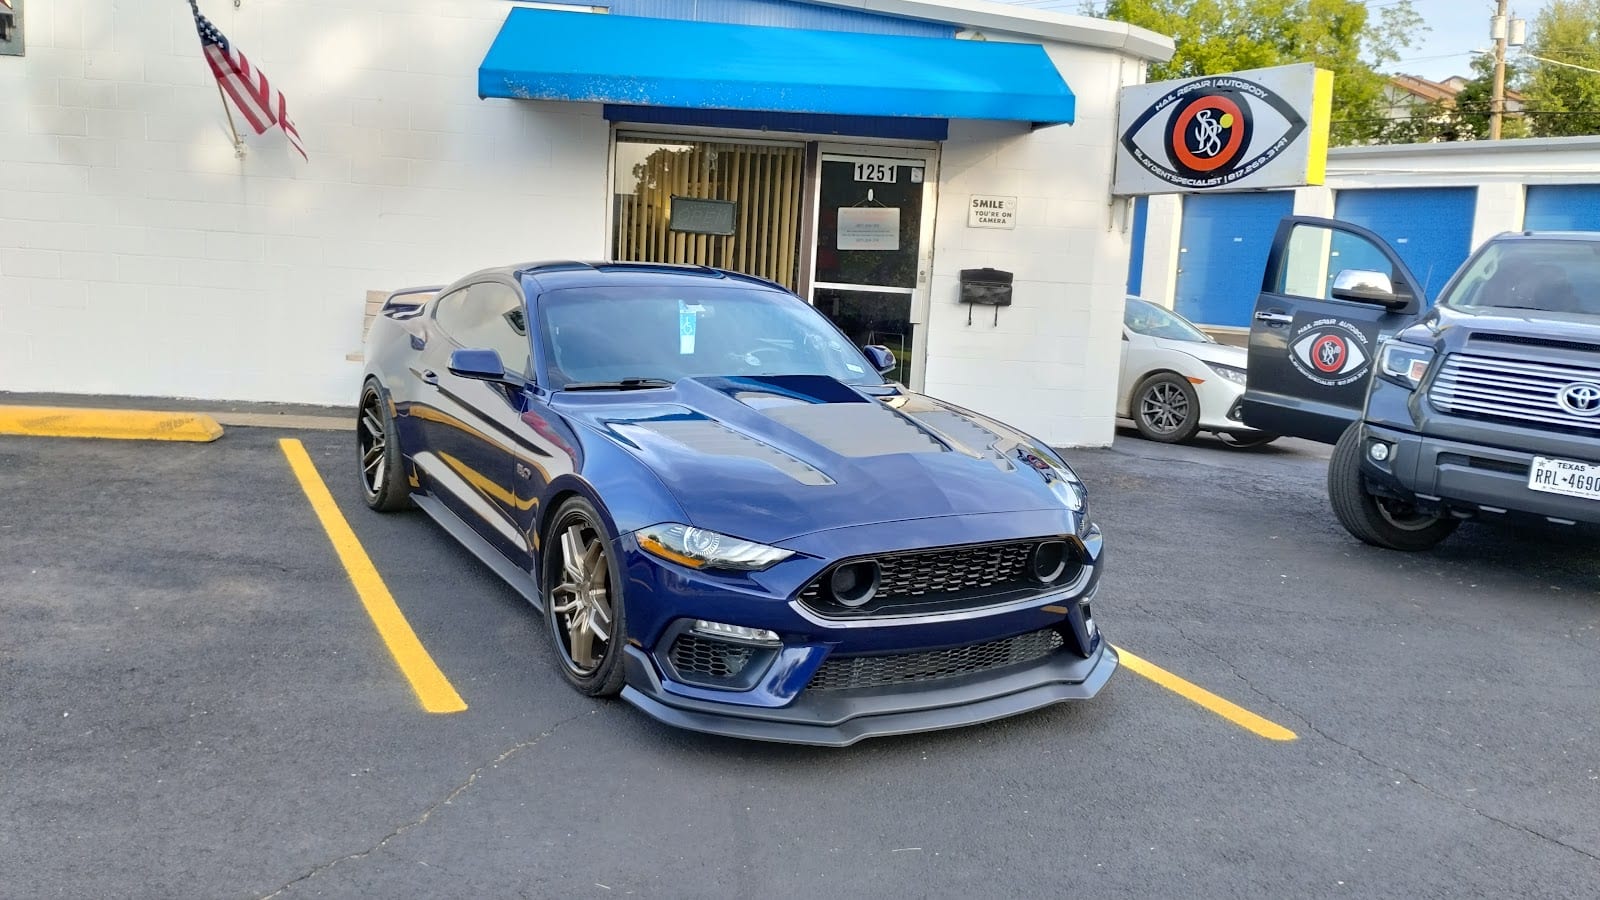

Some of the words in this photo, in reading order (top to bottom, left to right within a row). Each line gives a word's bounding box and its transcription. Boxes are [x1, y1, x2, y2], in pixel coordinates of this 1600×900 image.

[1155, 94, 1176, 111] HAIL
[1176, 80, 1211, 97] REPAIR
[1216, 79, 1269, 99] AUTOBODY
[857, 163, 895, 182] 1251
[972, 199, 1004, 209] SMILE
[975, 210, 1000, 218] YOU'RE
[1338, 321, 1369, 345] AUTOBODY
[1557, 462, 1586, 472] TEXAS
